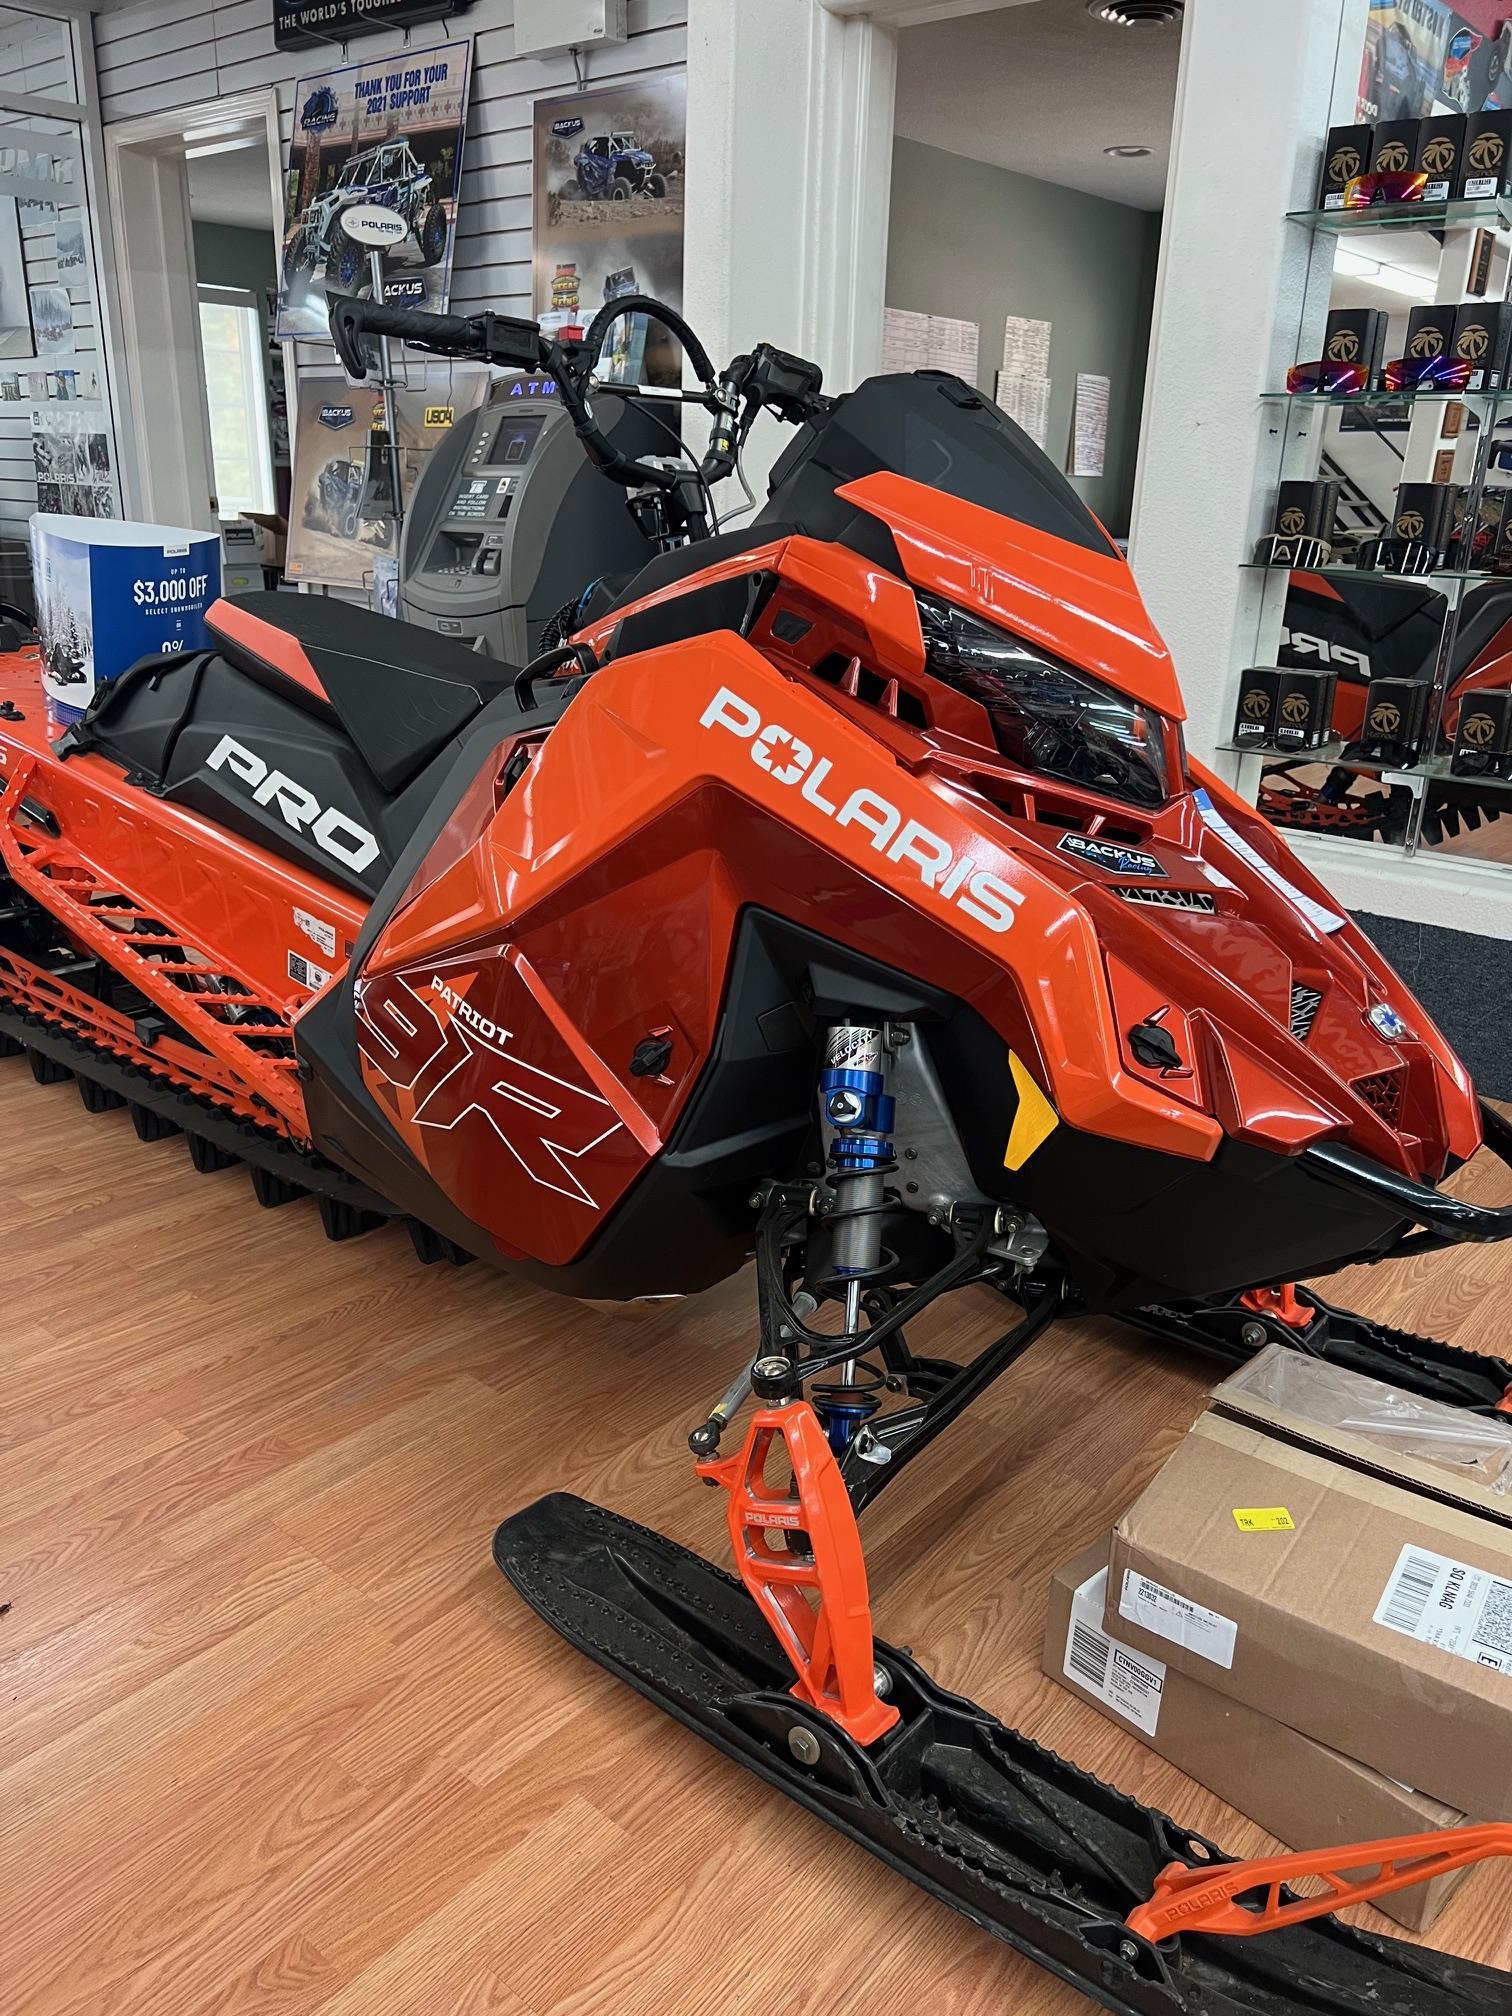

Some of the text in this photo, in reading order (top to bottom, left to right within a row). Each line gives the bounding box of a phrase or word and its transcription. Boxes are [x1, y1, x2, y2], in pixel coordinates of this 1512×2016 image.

[279, 14, 297, 30] THE
[300, 1, 347, 24] WORLD'S
[354, 63, 448, 99] THANK YOU FOR YOUR
[366, 86, 431, 115] 2021 SUPPORT
[302, 113, 336, 128] RACING
[554, 120, 581, 130] BACKUS
[362, 220, 402, 231] POLARIS
[384, 282, 422, 296] ACKUS
[510, 382, 556, 396] ATM
[322, 408, 352, 417] BACKUS
[38, 472, 75, 483] POLARIS
[134, 574, 208, 606] $3,000 OFF
[145, 608, 168, 616] SELECT
[205, 734, 380, 873] PRO
[698, 686, 1026, 933] POLARIS
[1066, 836, 1156, 868] BACKUS
[430, 975, 514, 1046] PATRIOT
[830, 1030, 873, 1064] VELOCITY
[744, 1512, 800, 1526] POLARIS
[1240, 1518, 1254, 1526] TRK
[1165, 1880, 1239, 1922] POLARIS
